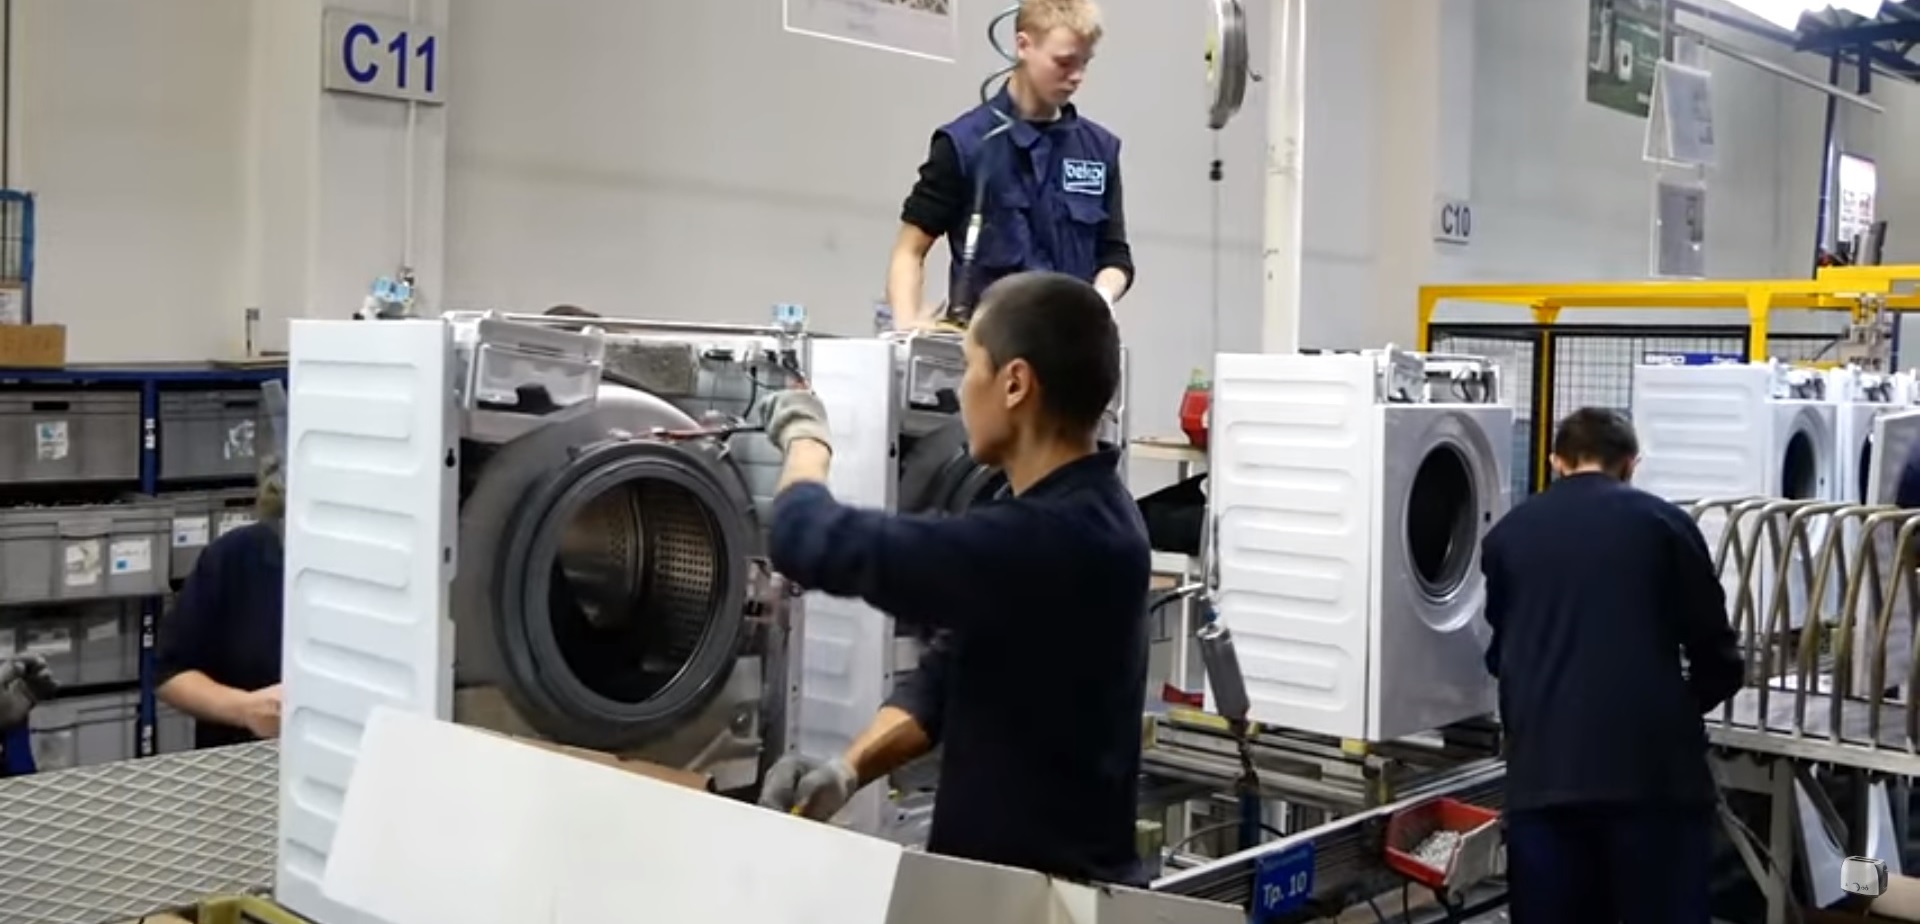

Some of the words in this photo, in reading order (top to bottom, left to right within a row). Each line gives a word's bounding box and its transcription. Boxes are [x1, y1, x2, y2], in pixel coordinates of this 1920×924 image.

[343, 22, 435, 93] C11
[1441, 203, 1471, 237] C10
[1288, 871, 1307, 896] 10
